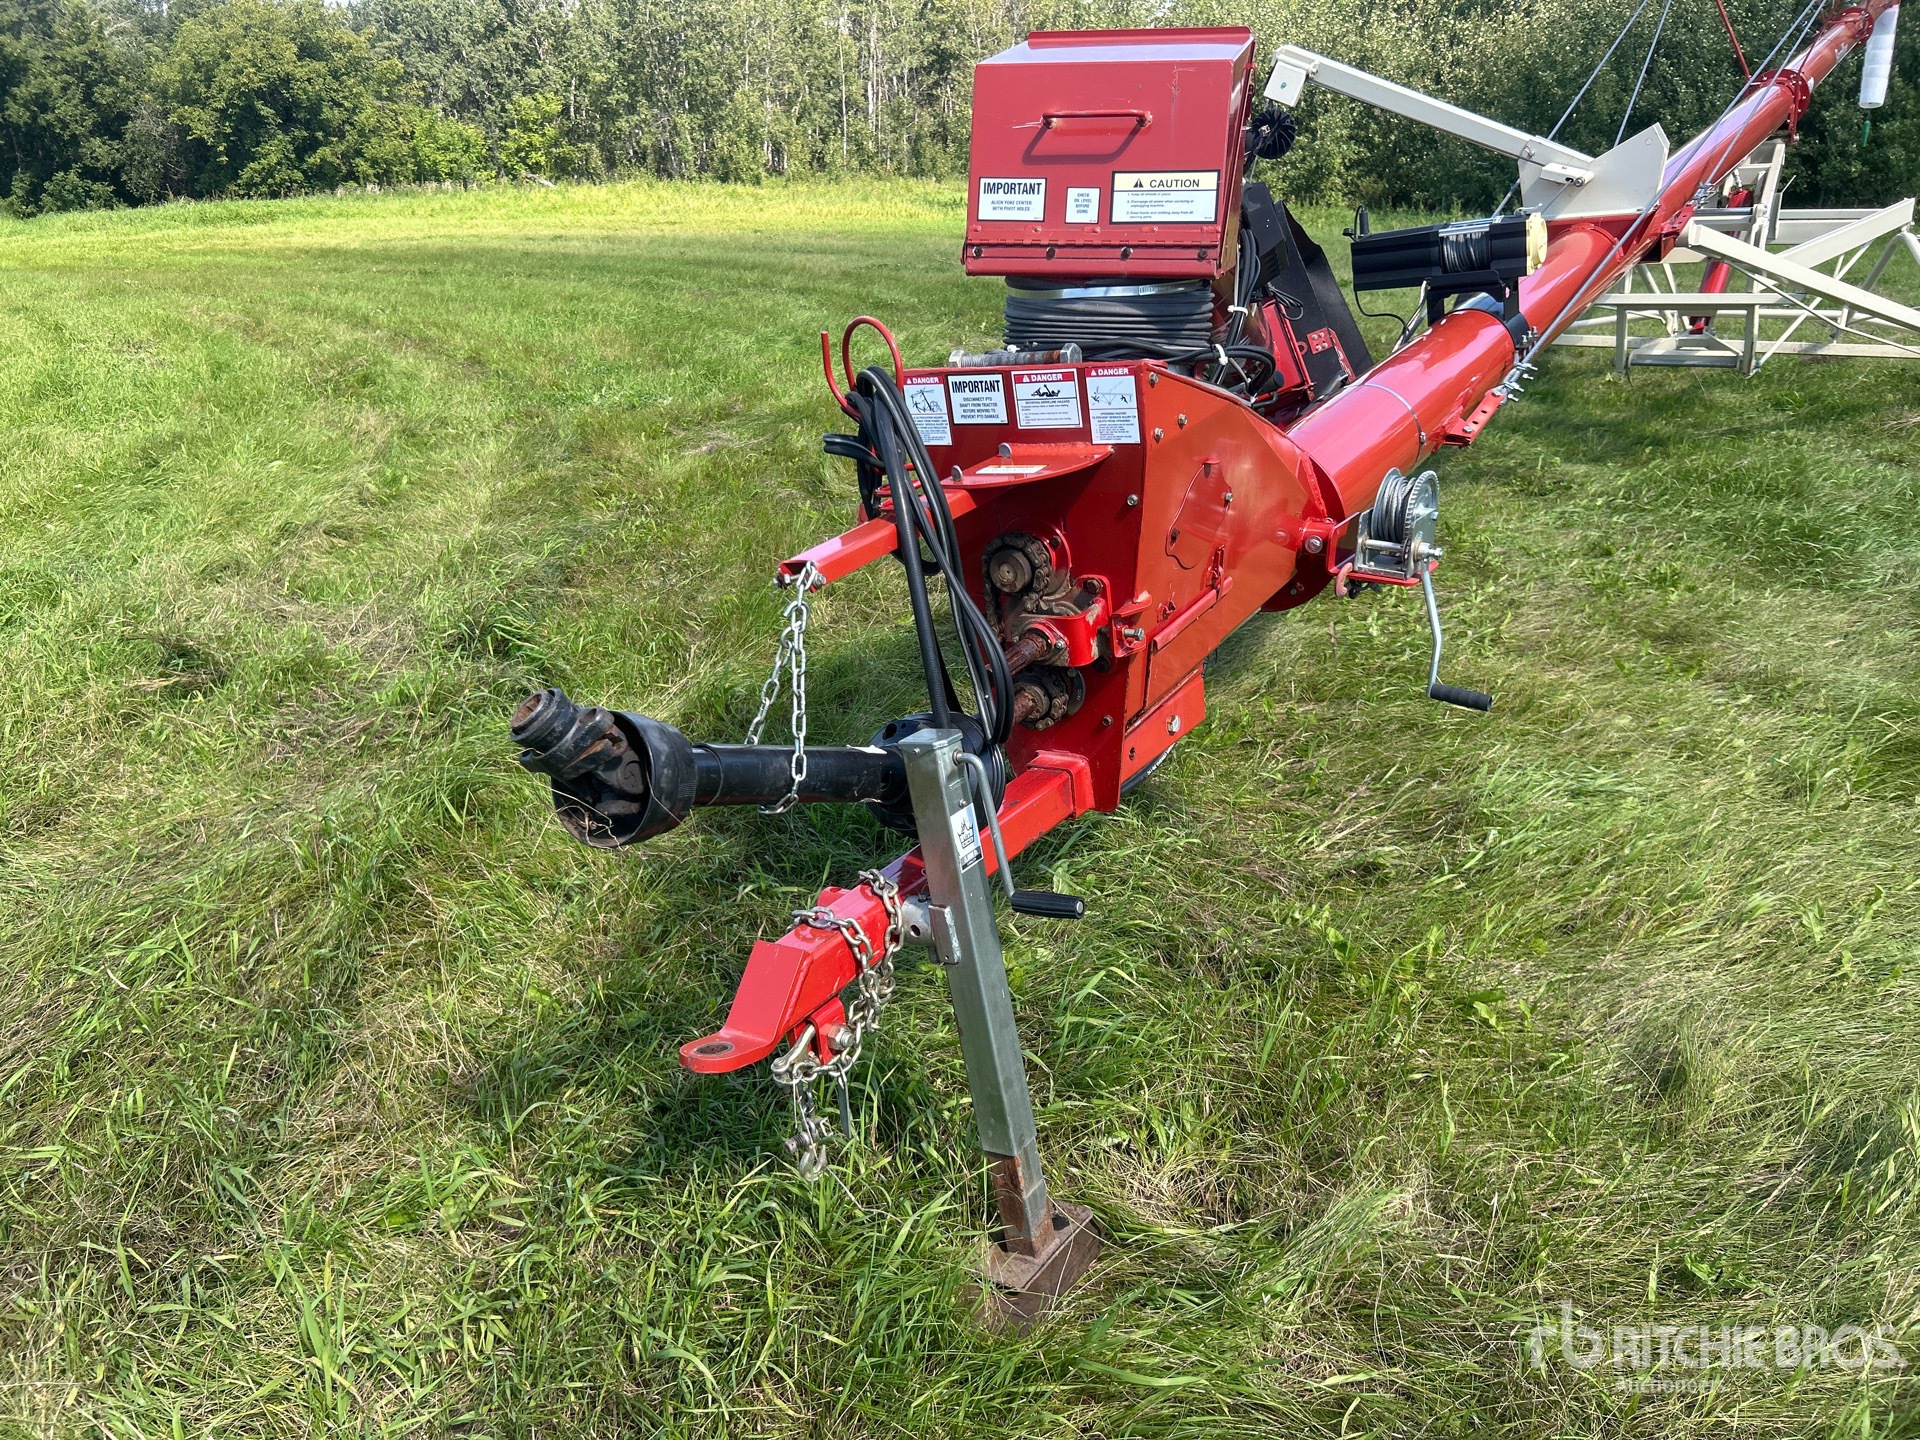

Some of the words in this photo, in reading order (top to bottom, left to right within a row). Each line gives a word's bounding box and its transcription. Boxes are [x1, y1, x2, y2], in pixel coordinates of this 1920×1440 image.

[1149, 179, 1200, 188] CAUTION
[983, 182, 1042, 195] IMPORTANT
[1098, 368, 1129, 376] DANGER
[1031, 373, 1063, 382] DANGER
[951, 380, 1000, 394] IMPORTANT
